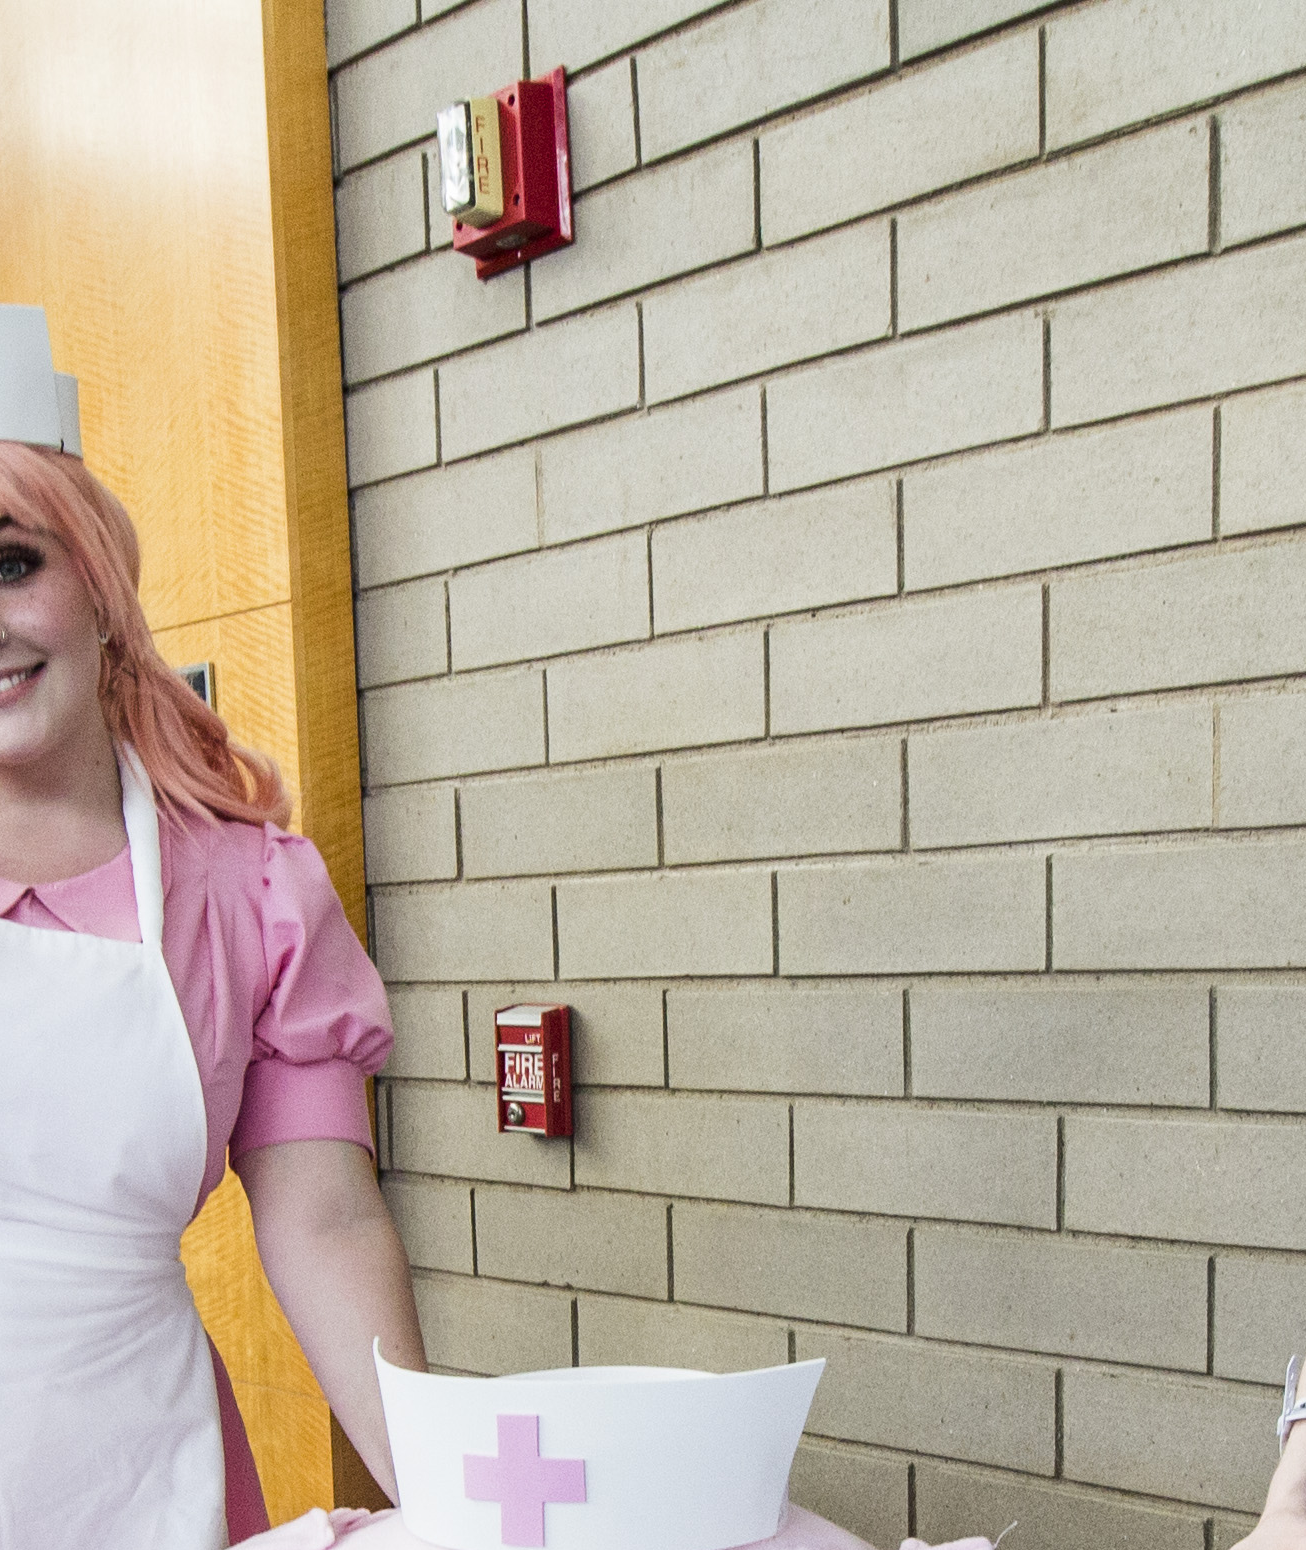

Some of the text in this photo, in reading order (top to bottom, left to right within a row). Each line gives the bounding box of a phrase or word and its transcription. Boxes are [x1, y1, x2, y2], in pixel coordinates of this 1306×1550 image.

[475, 114, 490, 195] FIRE
[504, 1052, 543, 1076] FIRE
[504, 1073, 543, 1090] ALARM
[552, 1053, 561, 1103] FIRE
